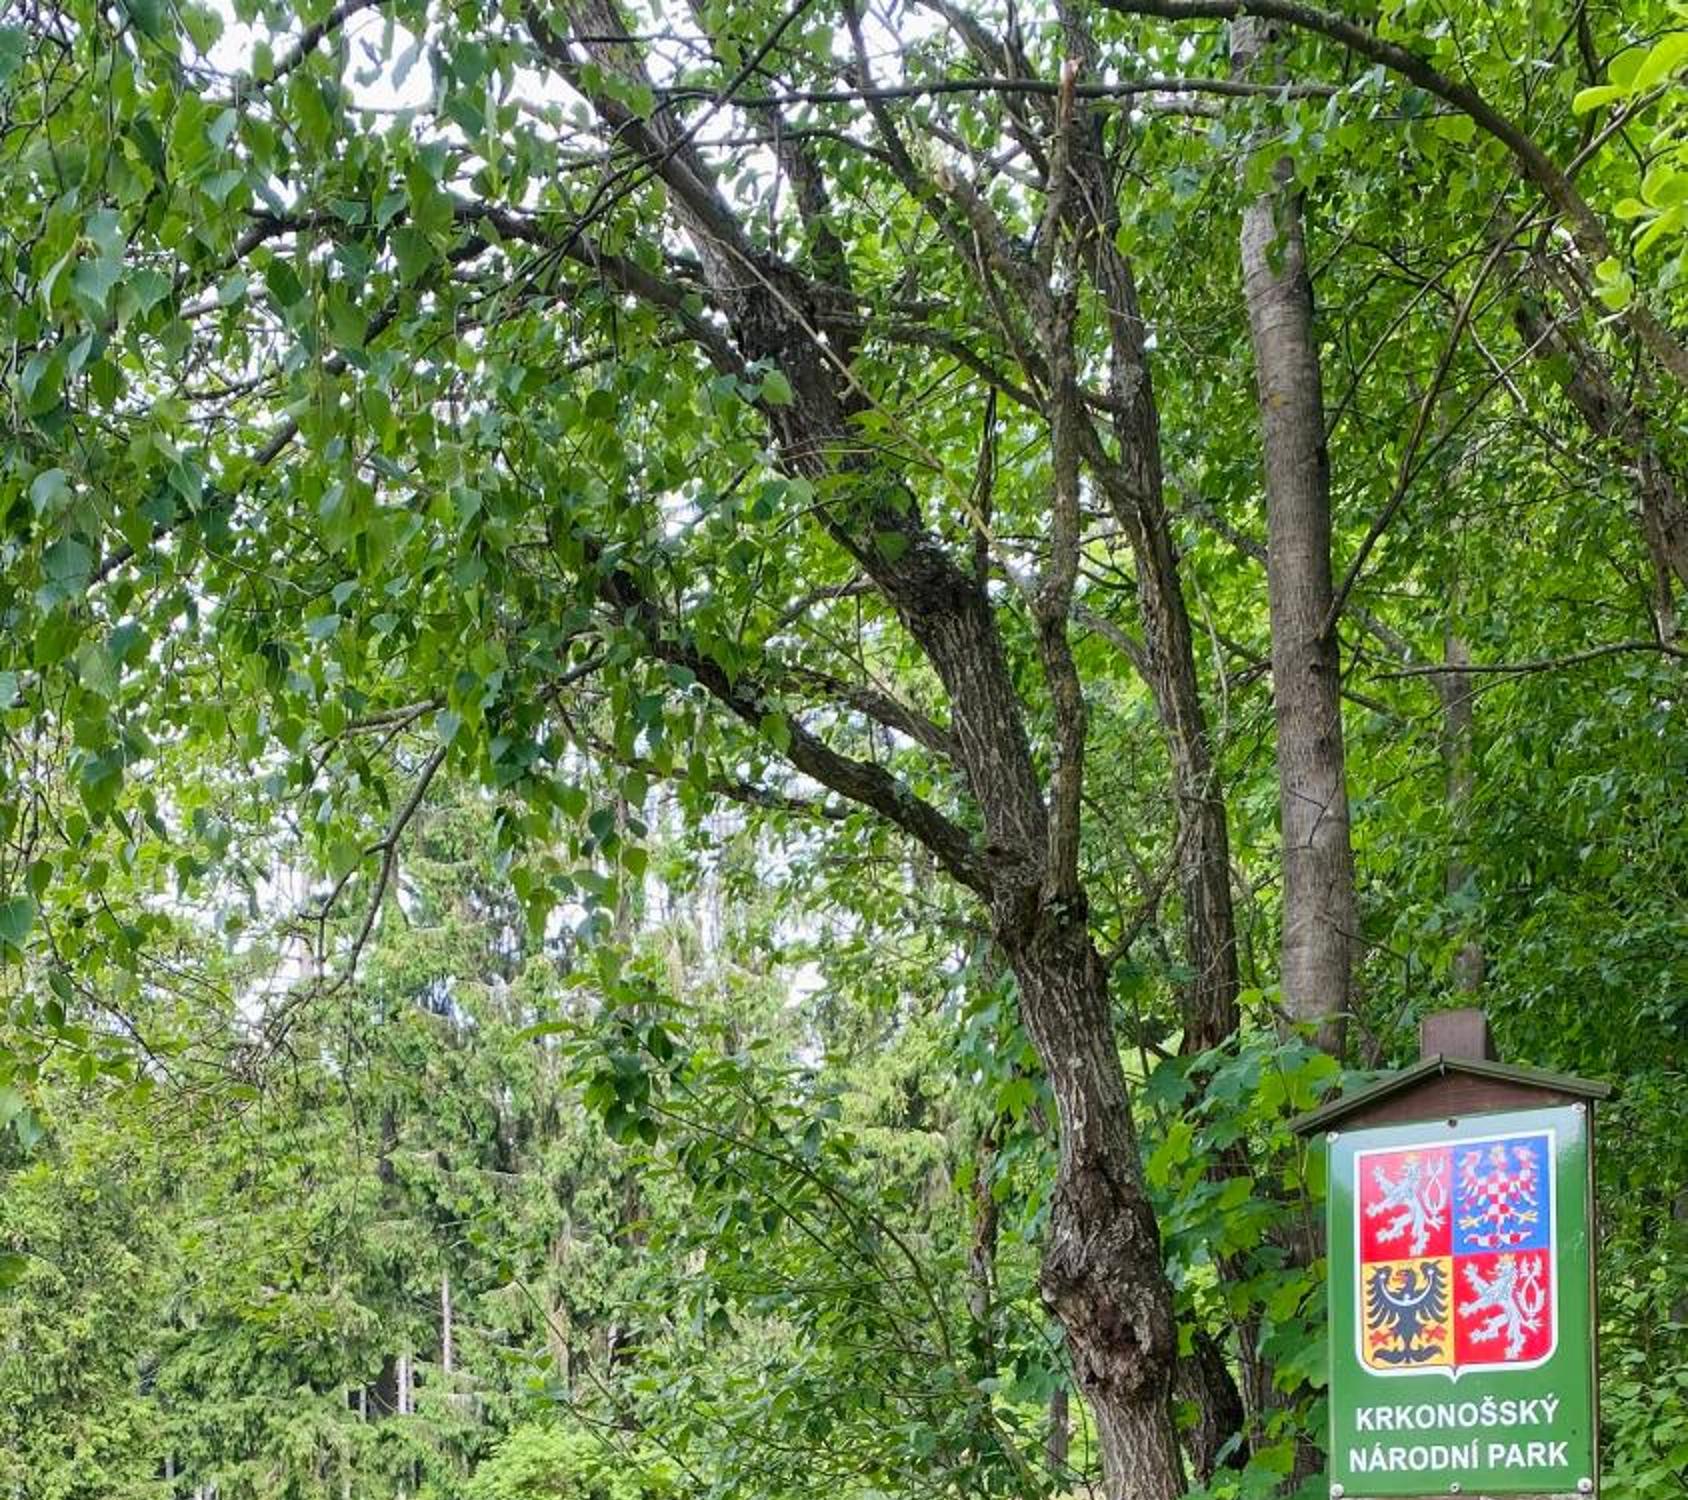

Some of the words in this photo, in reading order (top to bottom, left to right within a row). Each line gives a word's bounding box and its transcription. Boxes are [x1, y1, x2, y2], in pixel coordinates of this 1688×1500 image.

[1356, 1393, 1559, 1430] KRKONOŠSKÝ
[1349, 1438, 1480, 1472] NÁRODNÍ
[1487, 1441, 1568, 1468] PARK
